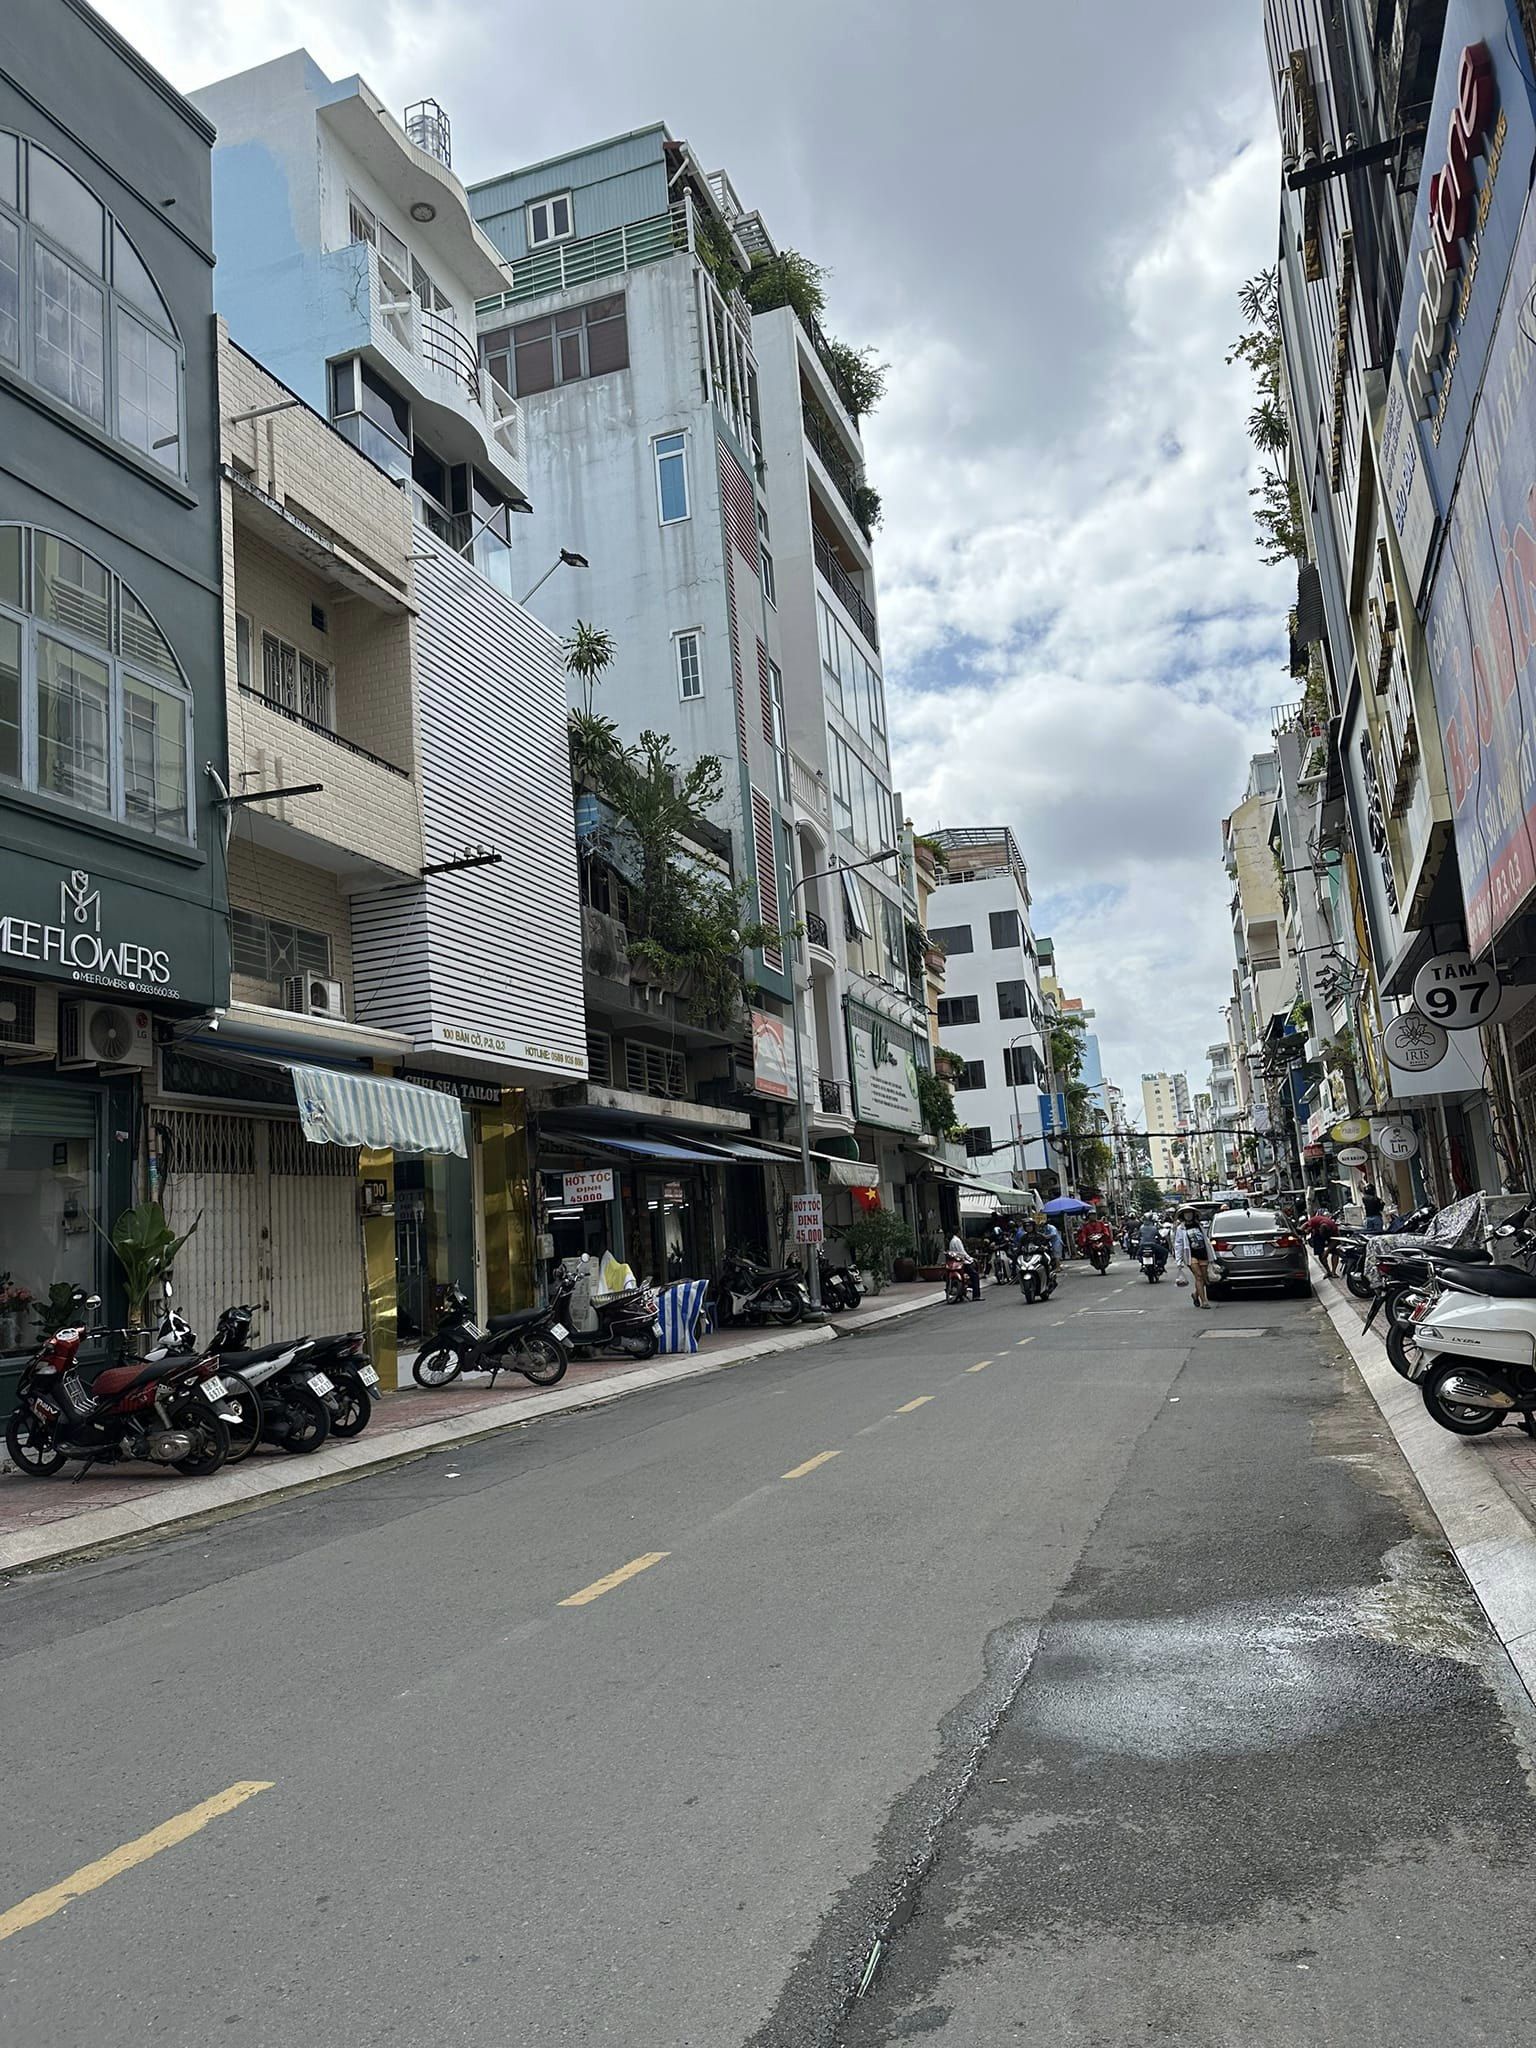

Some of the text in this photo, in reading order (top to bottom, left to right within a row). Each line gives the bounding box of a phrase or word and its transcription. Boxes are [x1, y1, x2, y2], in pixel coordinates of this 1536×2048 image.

[44, 925, 171, 984] FLOWERS
[1431, 964, 1477, 981] TÂM
[95, 974, 127, 989] FLOWERS
[1425, 981, 1490, 1018] 97
[137, 1030, 147, 1039] LG
[442, 1027, 455, 1040] 100
[1405, 1049, 1430, 1061] IRIS
[589, 1170, 612, 1184] TÓC
[795, 1228, 822, 1243] 45.000
